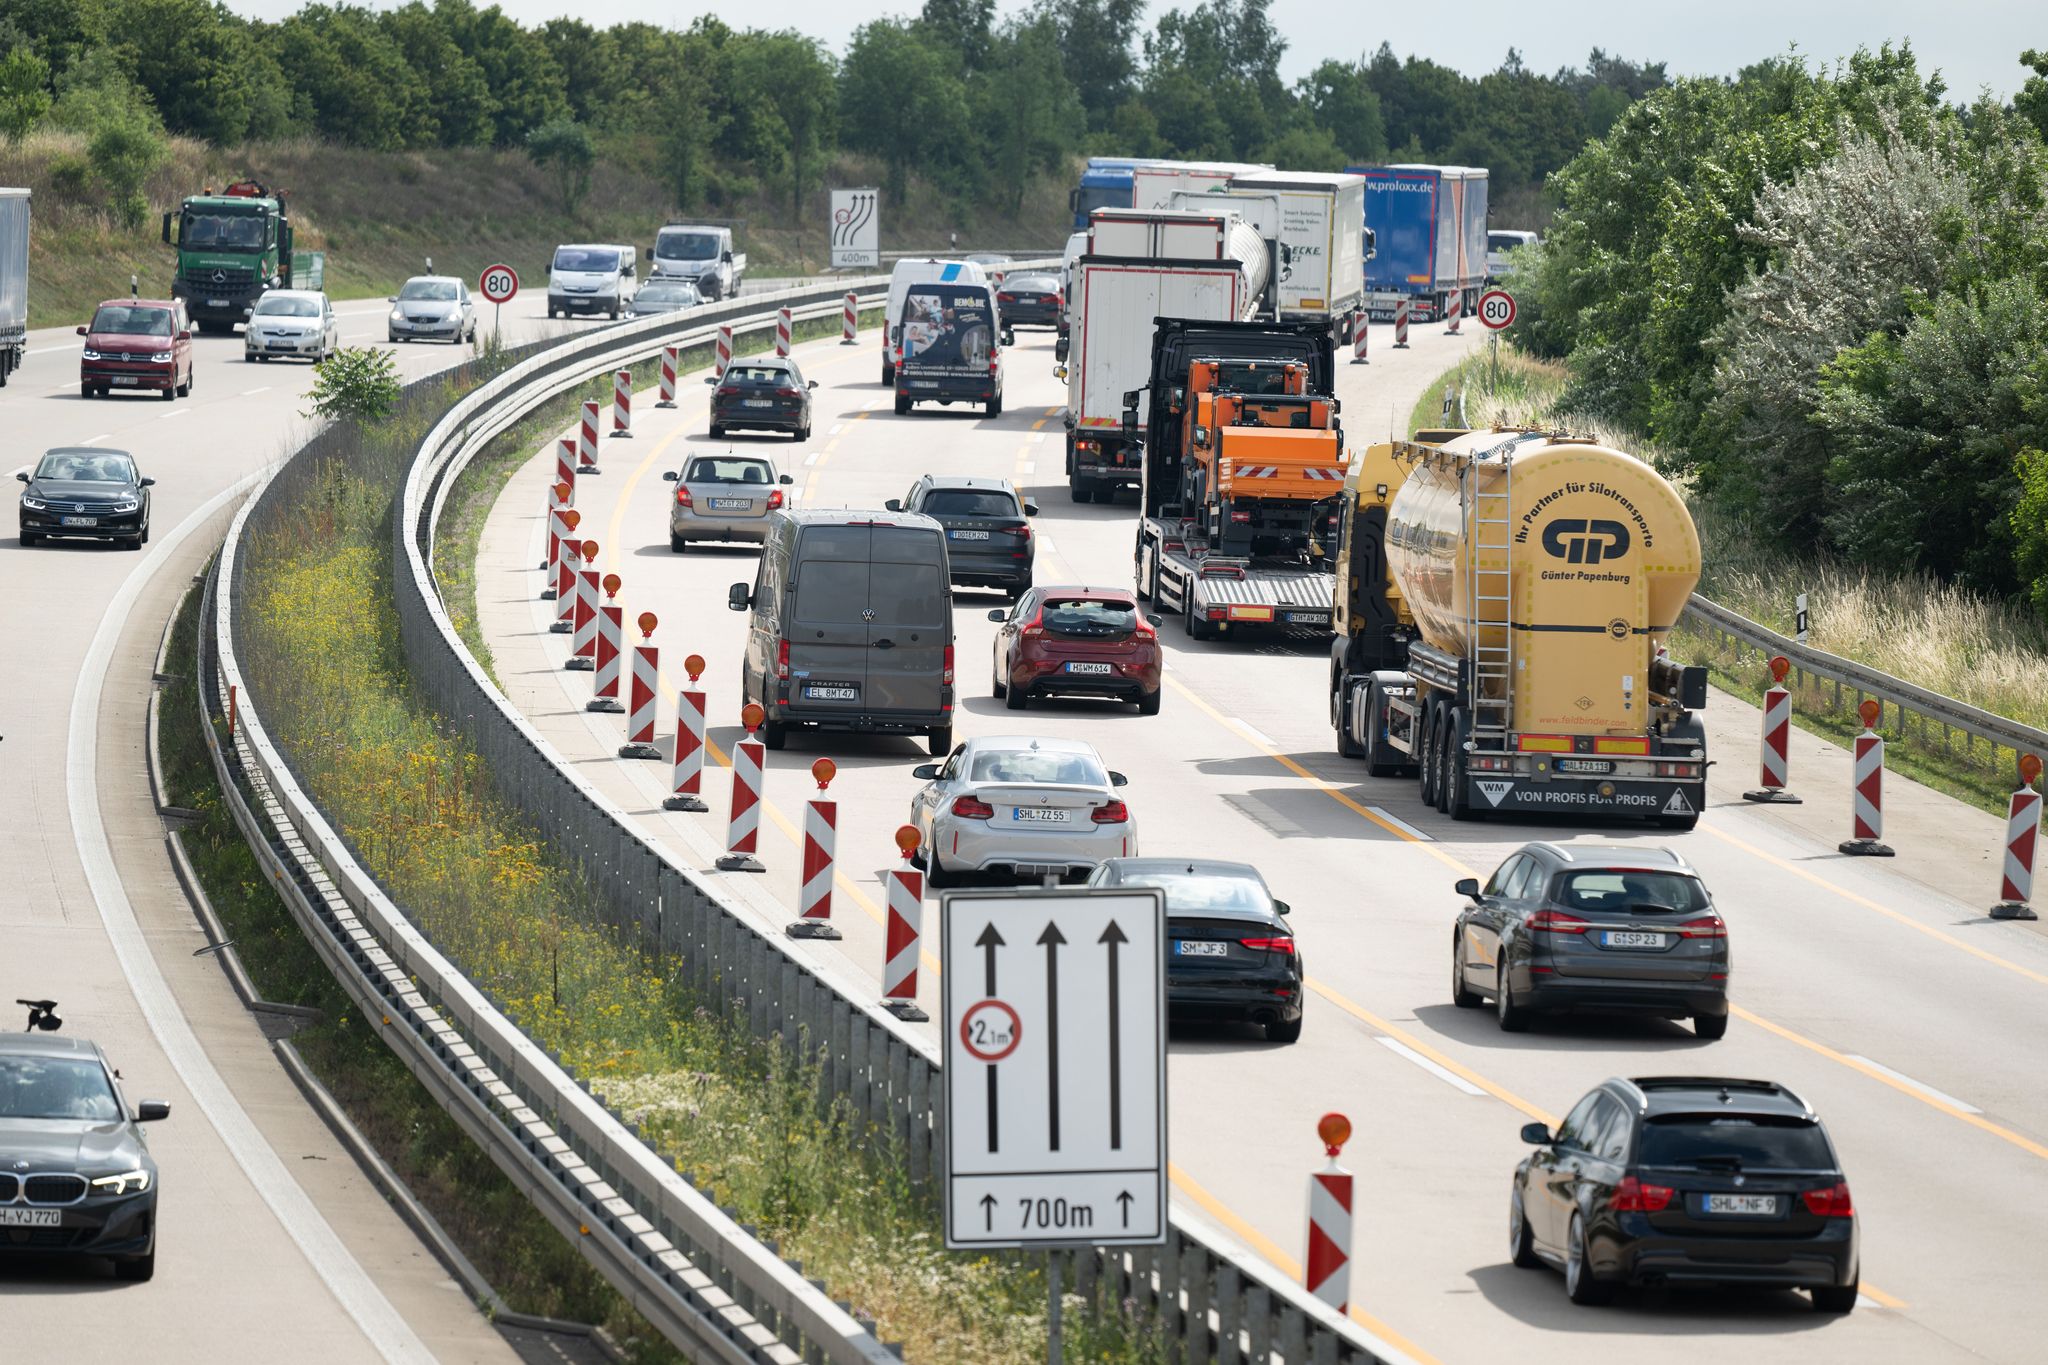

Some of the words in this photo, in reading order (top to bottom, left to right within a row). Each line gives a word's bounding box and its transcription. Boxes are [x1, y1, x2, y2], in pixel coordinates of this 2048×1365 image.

[841, 253, 870, 263] 400m
[488, 275, 510, 293] 80
[1485, 301, 1508, 319] 80
[1514, 524, 1529, 544] Ihr
[1522, 487, 1565, 524] Partner
[1565, 482, 1587, 494] für
[1588, 482, 1653, 548] Silotransporte
[1541, 570, 1575, 581] Günter
[1576, 571, 1630, 586] Papenburg
[1094, 665, 1108, 673] 614
[811, 688, 822, 697] EL
[1538, 714, 1628, 727] www.feldbinder.com
[1483, 783, 1505, 792] WM
[1515, 791, 1542, 802] VON
[1545, 792, 1586, 804] PROFIS
[1615, 794, 1657, 806] PROFIS
[1019, 809, 1035, 819] SHL
[1041, 810, 1052, 820] ZZ
[1053, 810, 1064, 820] 55
[1628, 934, 1642, 945] SP
[1643, 934, 1657, 945] 23
[1182, 942, 1197, 953] SM
[1203, 943, 1217, 954] JF
[1710, 1197, 1737, 1210] SHL
[1745, 1198, 1763, 1210] NF
[1766, 1198, 1775, 1211] 9
[15, 1210, 32, 1223] YJ
[35, 1210, 59, 1224] 770
[1019, 1198, 1093, 1230] 700m
